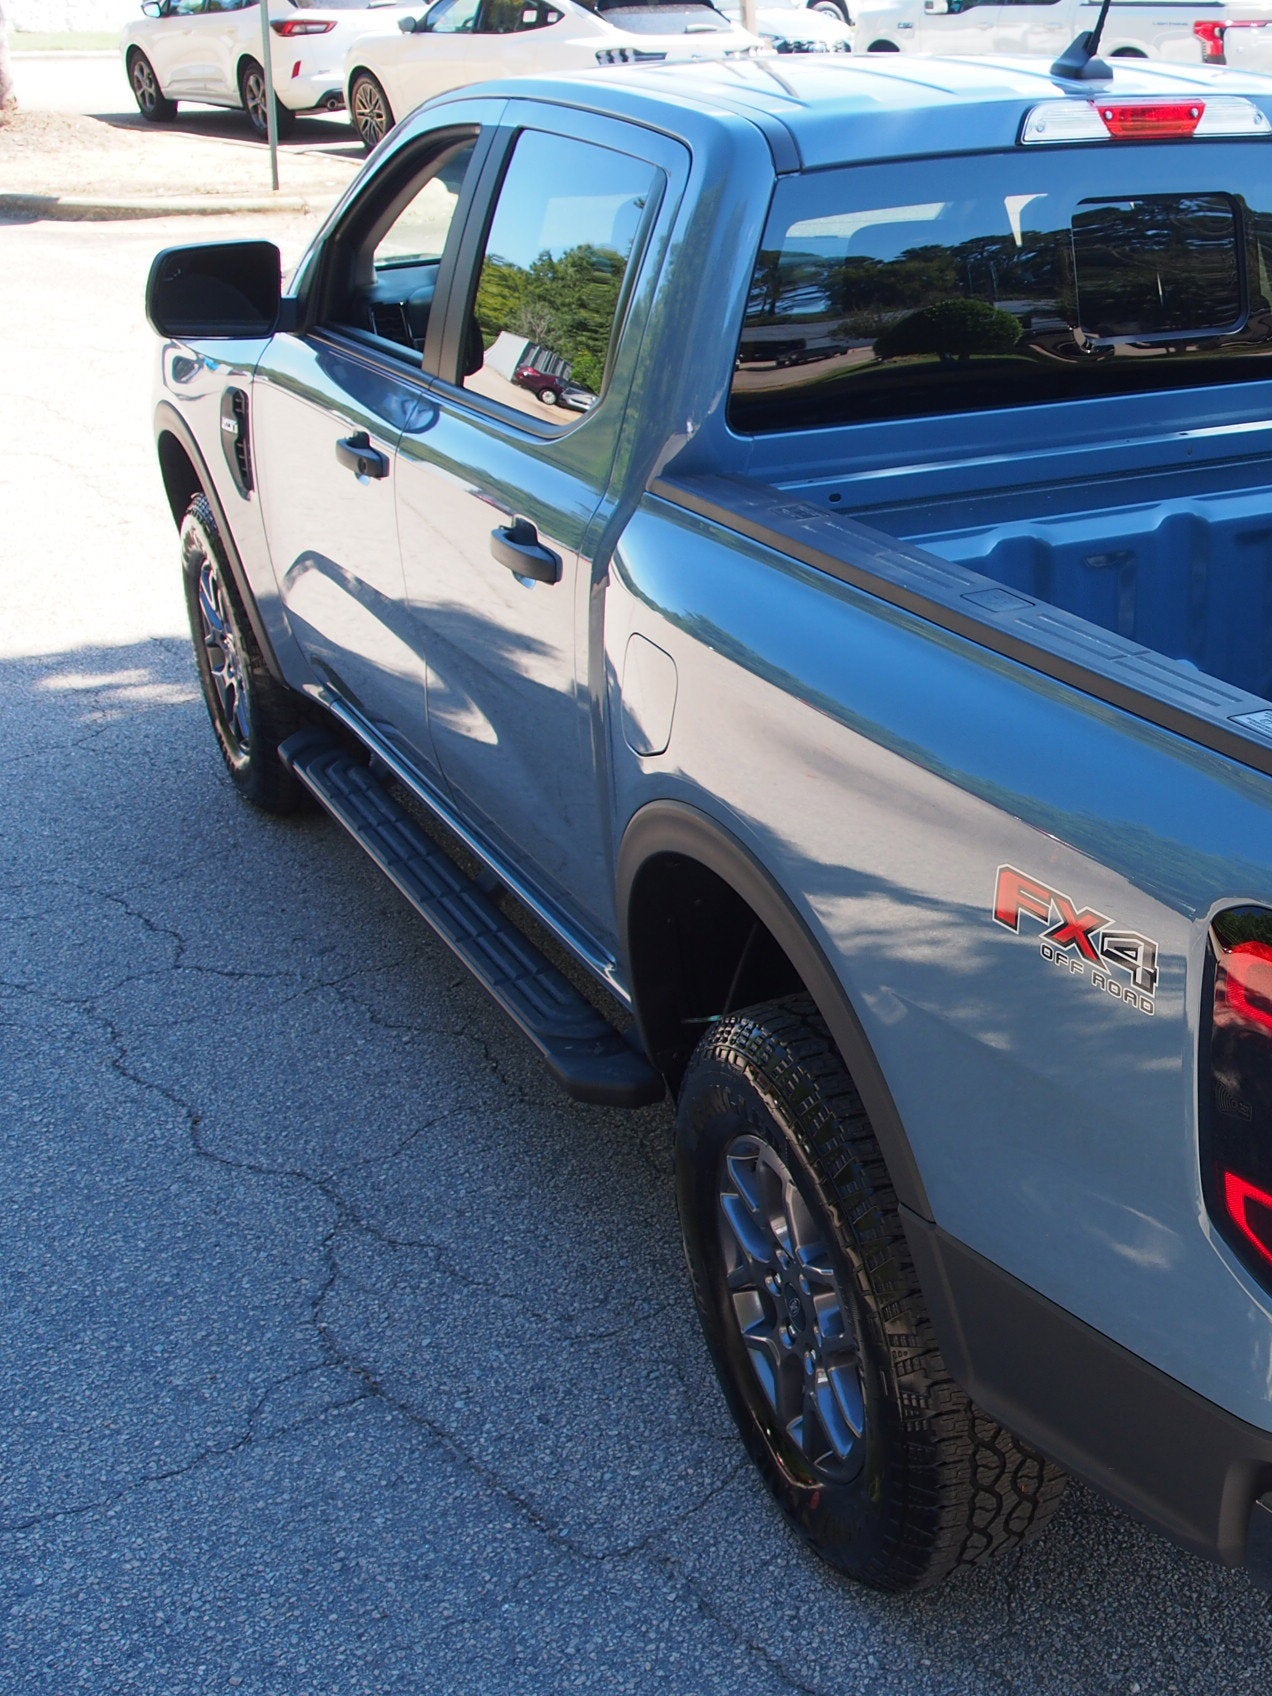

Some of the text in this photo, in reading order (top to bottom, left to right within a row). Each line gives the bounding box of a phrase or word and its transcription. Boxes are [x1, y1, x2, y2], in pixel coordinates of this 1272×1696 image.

[992, 863, 1160, 998] FX4
[1040, 943, 1155, 1016] OFF ROAD
